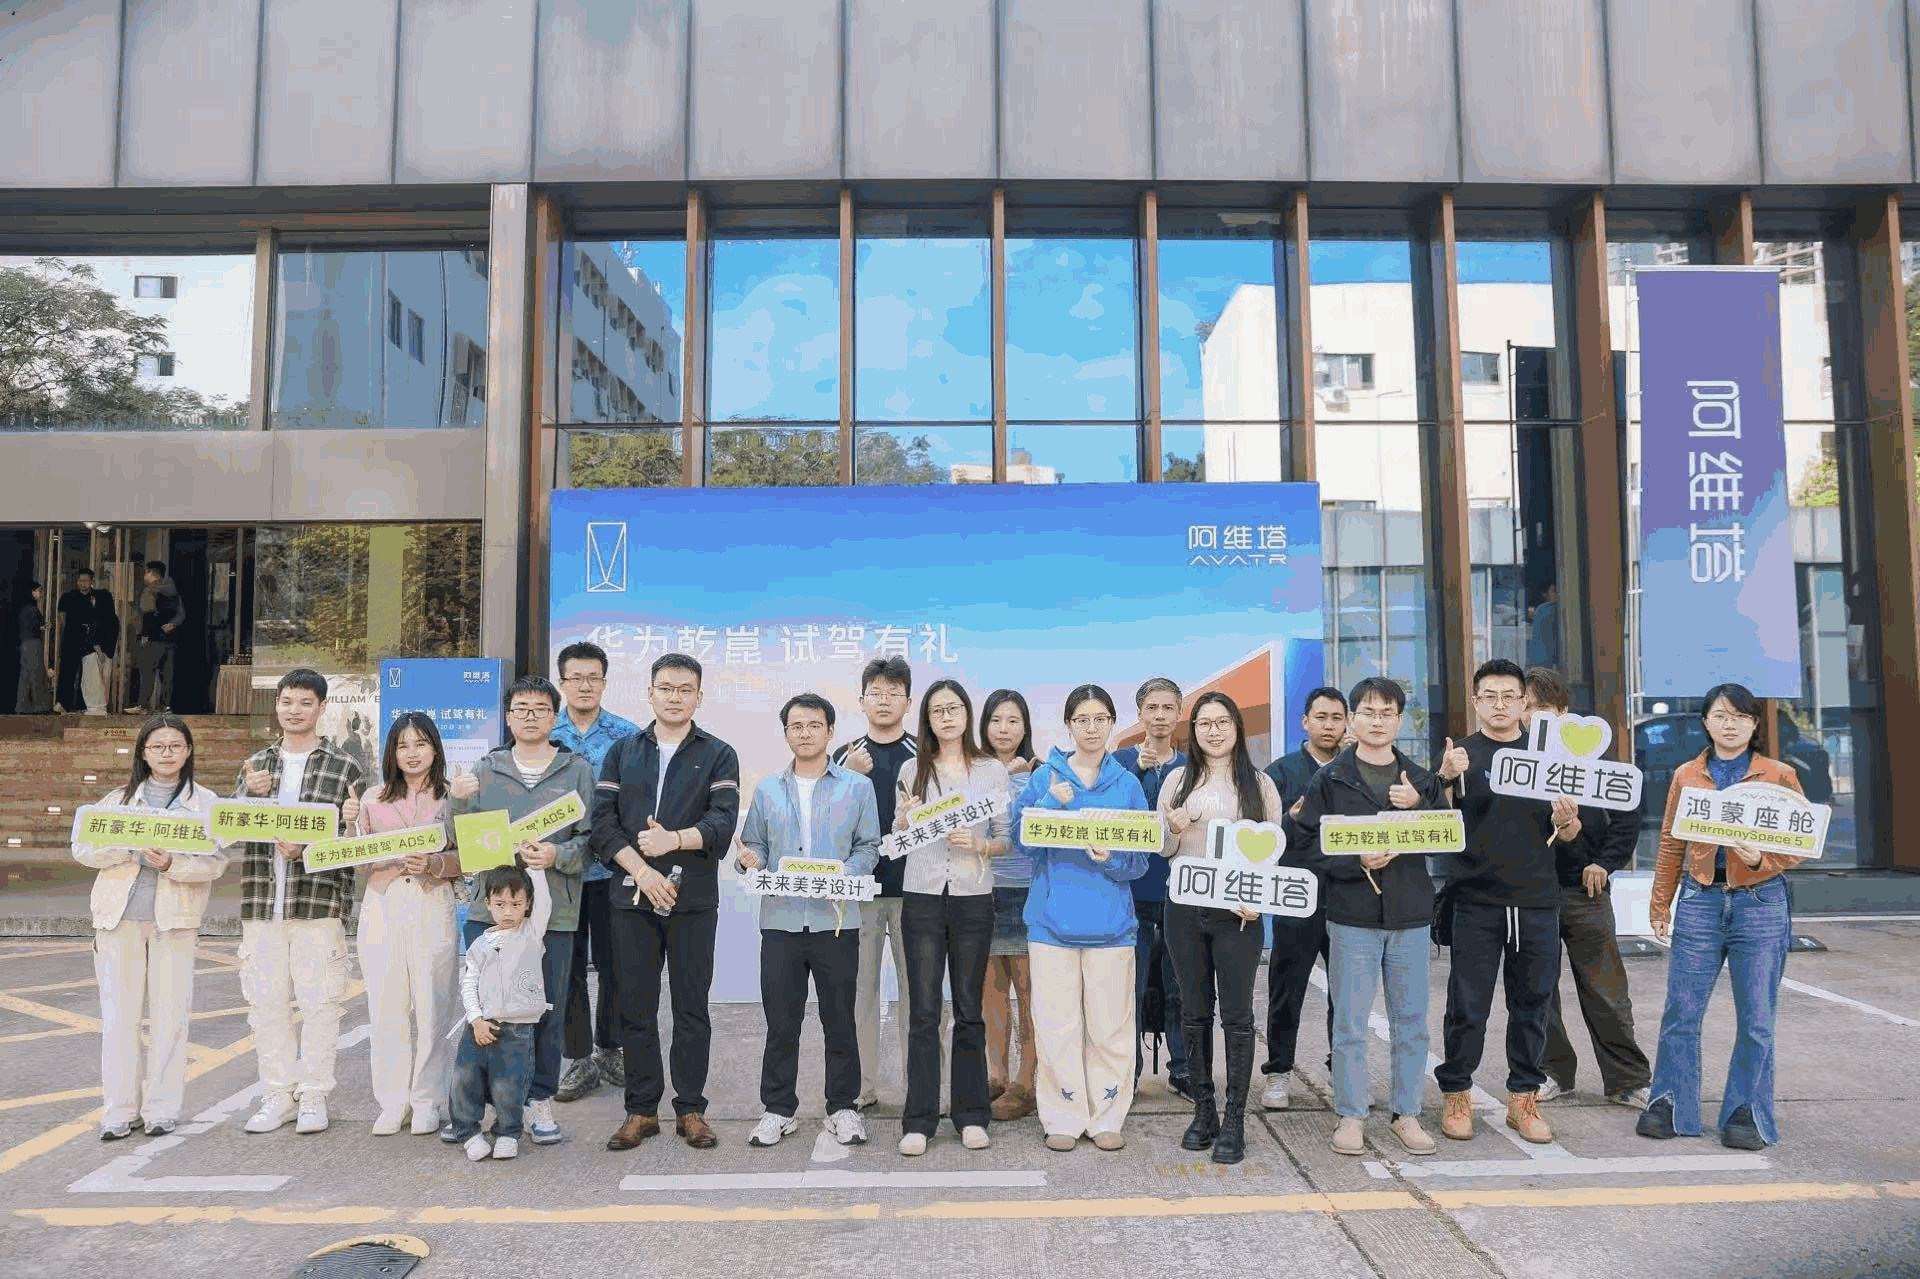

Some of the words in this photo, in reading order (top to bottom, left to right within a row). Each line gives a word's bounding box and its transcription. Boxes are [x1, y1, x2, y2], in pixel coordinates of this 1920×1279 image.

[1687, 380, 1746, 583] 阿维塔
[1188, 525, 1286, 549] 阿维塔
[781, 623, 959, 663] 试驾有礼
[1537, 719, 1549, 751] I
[1498, 757, 1634, 802] 阿维塔
[542, 808, 566, 828] ADS
[567, 804, 575, 814] 4
[895, 798, 995, 852] 未来美学设计
[1686, 796, 1815, 834] 鸿蒙座舱
[399, 835, 425, 849] ADS
[428, 833, 436, 844] 4
[1028, 823, 1089, 840] 华为乾崑
[1095, 827, 1156, 843] 试驾有礼
[1214, 826, 1225, 859] I
[1328, 831, 1390, 846] 华为乾崑
[1396, 828, 1458, 844] 试驾有礼
[1689, 822, 1791, 845] HarmonySpace
[1795, 836, 1803, 846] 5
[755, 873, 865, 897] 未来美学设计
[1178, 864, 1310, 909] 阿维塔
